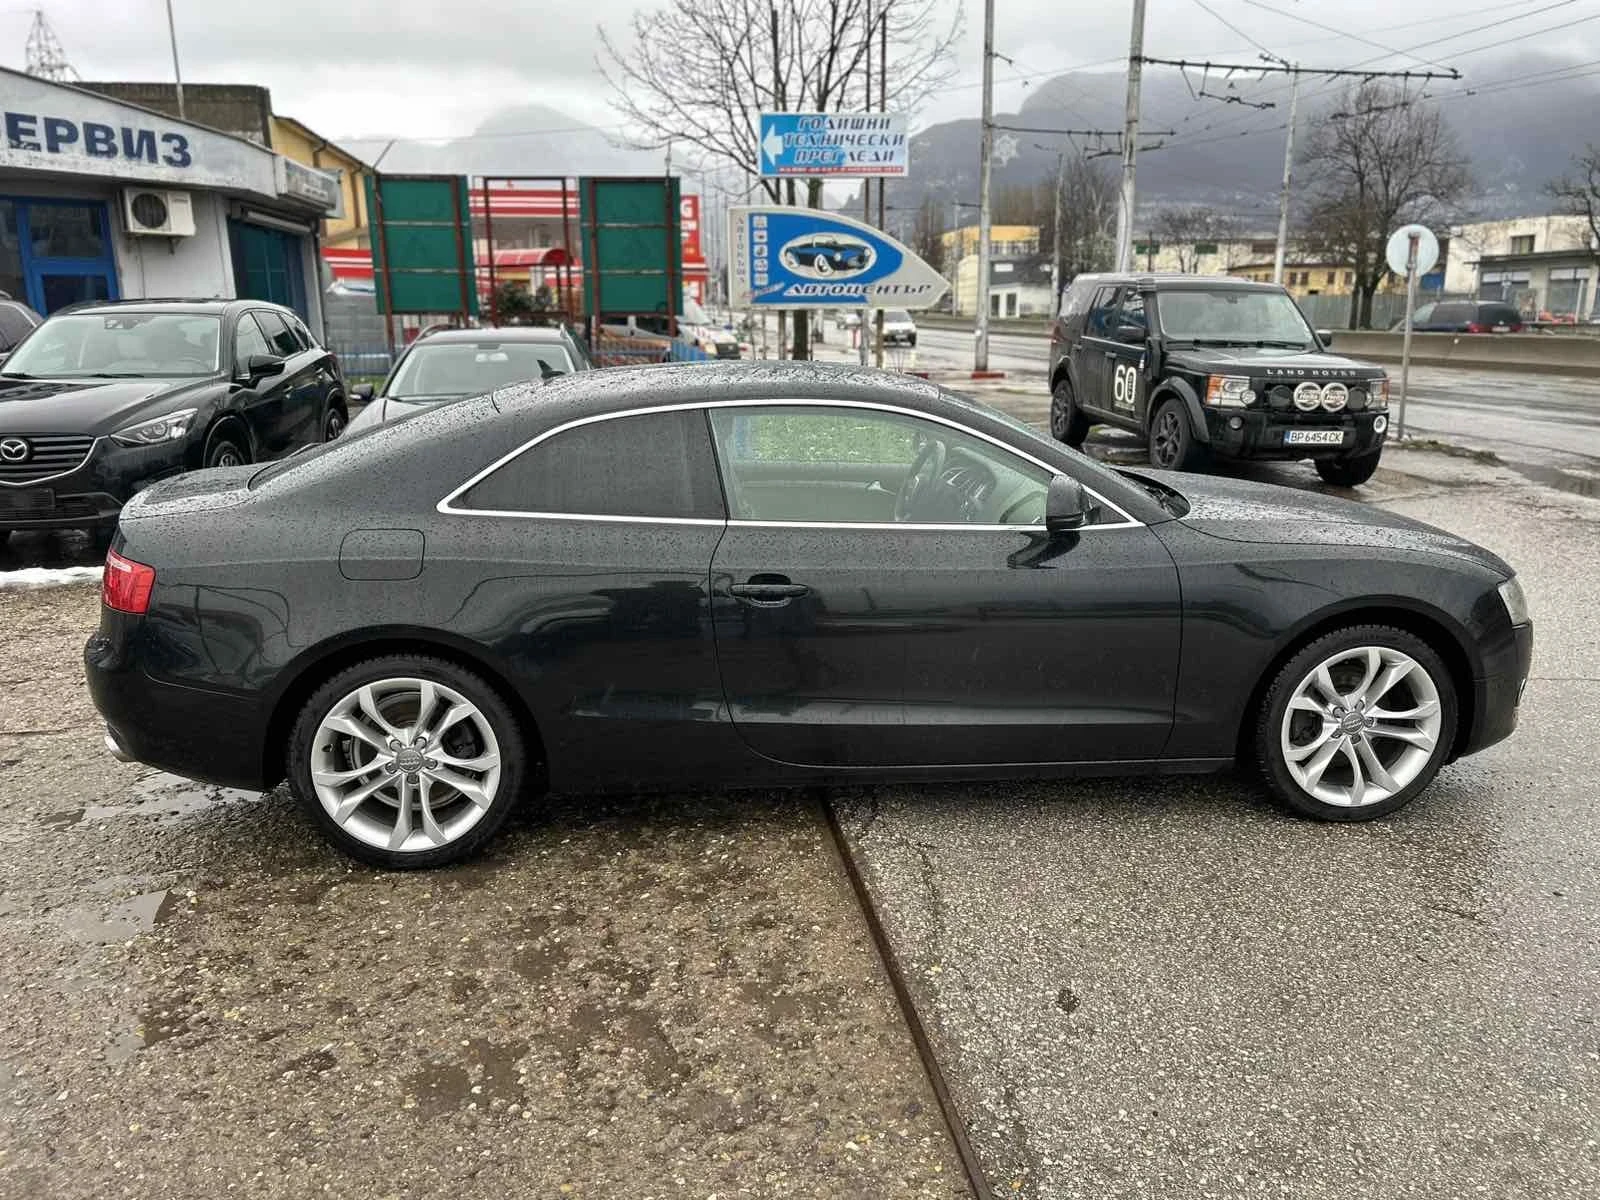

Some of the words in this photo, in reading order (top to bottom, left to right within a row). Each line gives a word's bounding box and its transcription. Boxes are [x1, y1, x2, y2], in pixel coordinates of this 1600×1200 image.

[798, 116, 891, 131] ГОДИШНИ
[784, 133, 905, 147] ТЕХНИЧЕСКИ
[1114, 364, 1137, 404] 60
[1305, 432, 1328, 442] 6454
